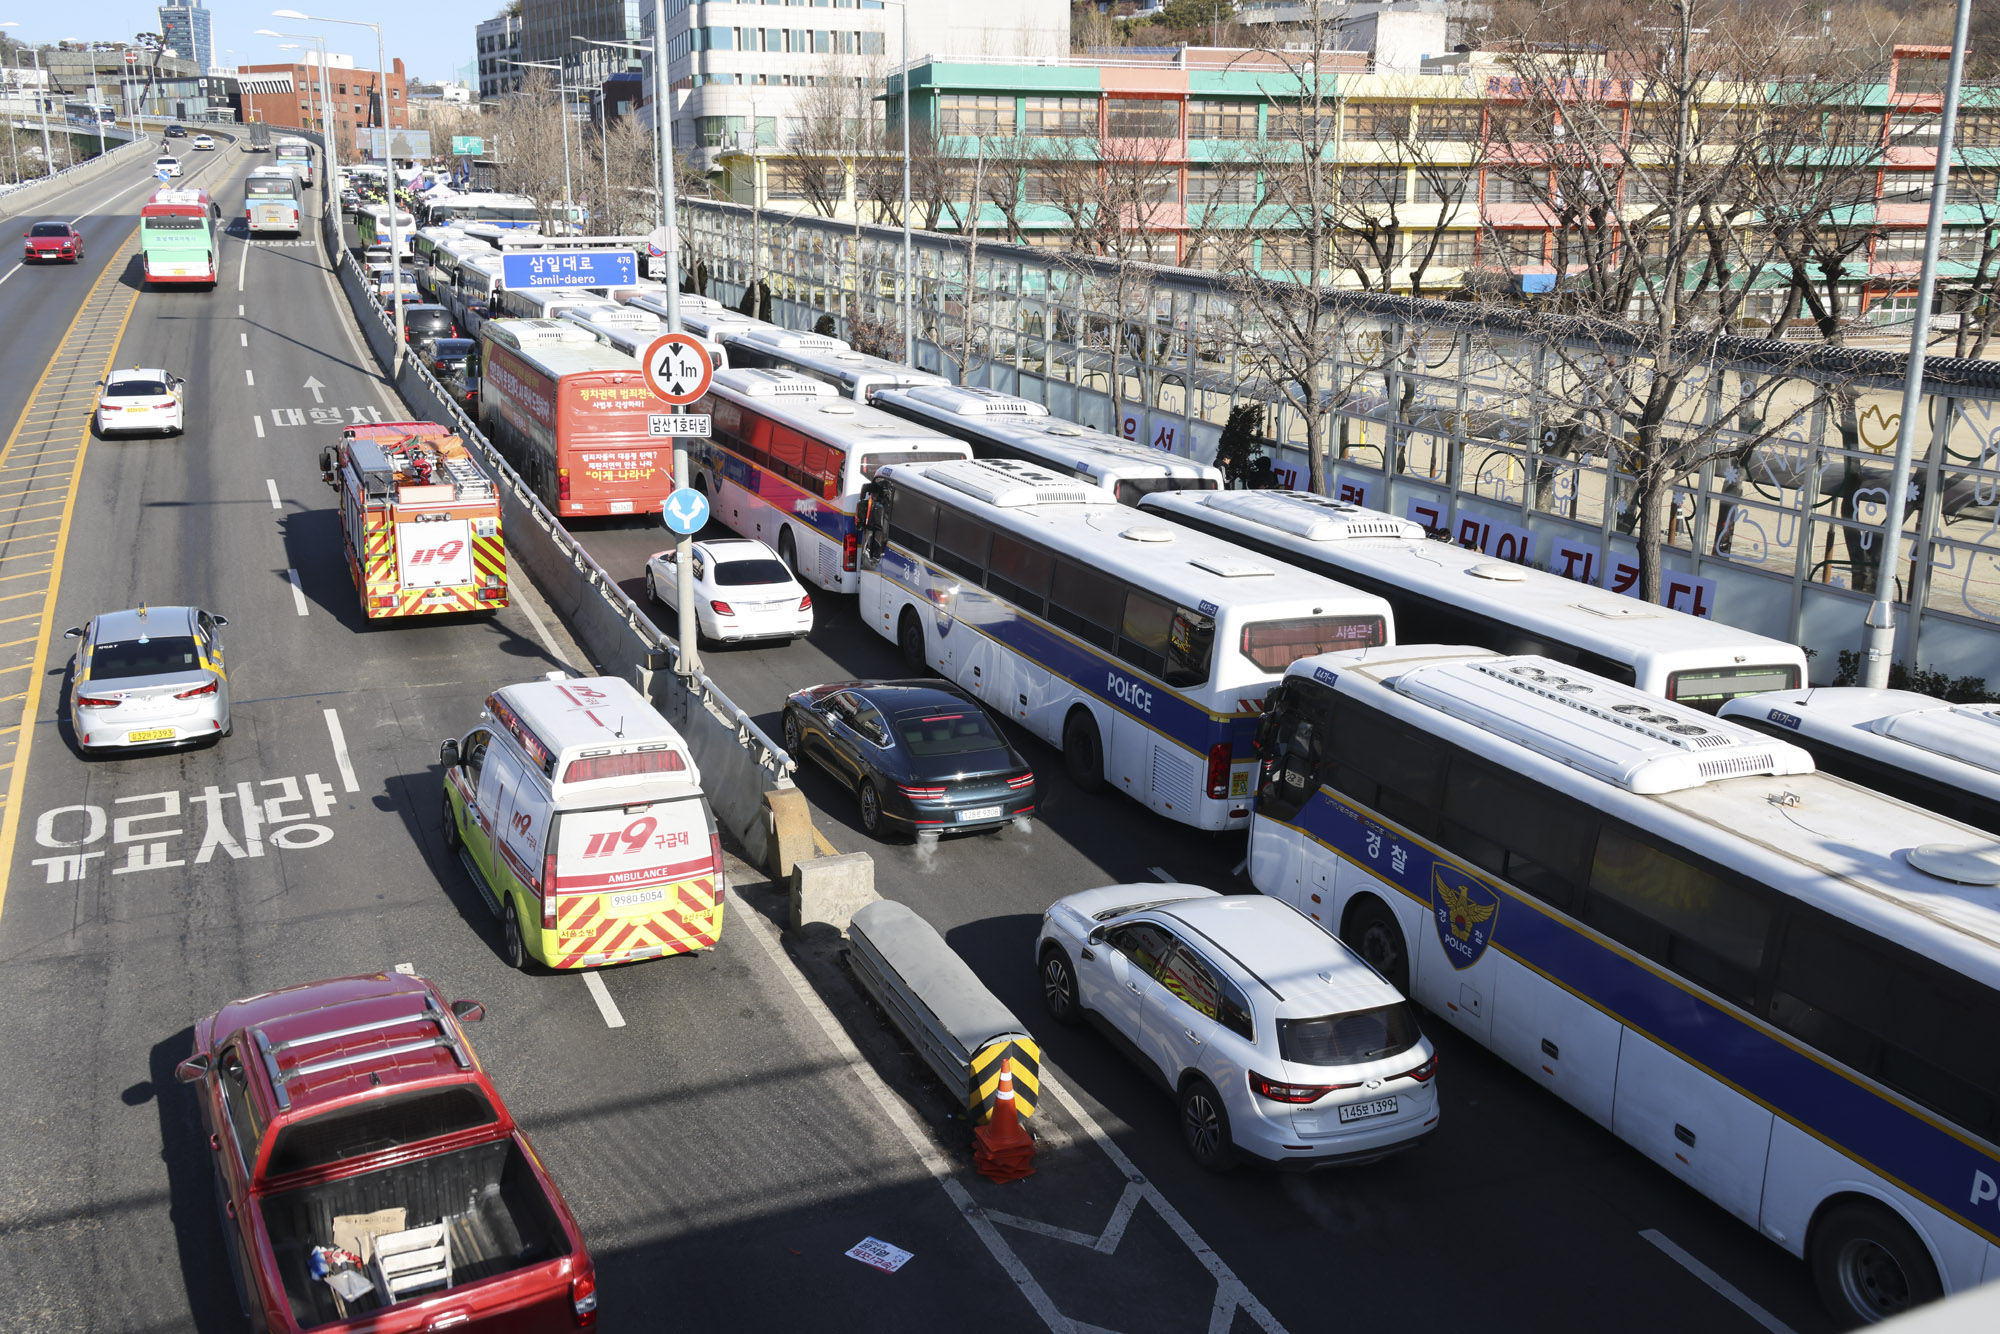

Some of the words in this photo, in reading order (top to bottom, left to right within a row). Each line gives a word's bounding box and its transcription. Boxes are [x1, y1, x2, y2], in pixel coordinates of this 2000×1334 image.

[529, 256, 594, 273] 삼일대로
[617, 256, 631, 264] 476
[530, 274, 595, 285] Samil-daero
[623, 275, 628, 283] 2
[658, 356, 697, 382] 4.1m
[580, 389, 617, 401] 정치권력
[271, 406, 382, 427] 대형차
[794, 498, 818, 522] POLICE
[408, 540, 464, 567] 119
[1107, 671, 1152, 714] POLICE
[1770, 710, 1795, 725] 61기-1
[153, 729, 173, 739] 2393
[32, 773, 337, 884] 유료차량
[511, 811, 532, 838] 119
[582, 816, 658, 859] 119
[654, 831, 689, 849] 구급대
[1365, 829, 1408, 876] 경찰
[608, 867, 668, 884] AMBULANCE
[640, 890, 663, 902] 5054
[1438, 908, 1447, 923] 경
[561, 929, 595, 938] 서울소방
[1474, 930, 1483, 945] 찰
[1445, 933, 1473, 958] POLICE
[1343, 1105, 1369, 1119] 145보
[1370, 1099, 1393, 1116] 1399
[1970, 1168, 2000, 1213] P
